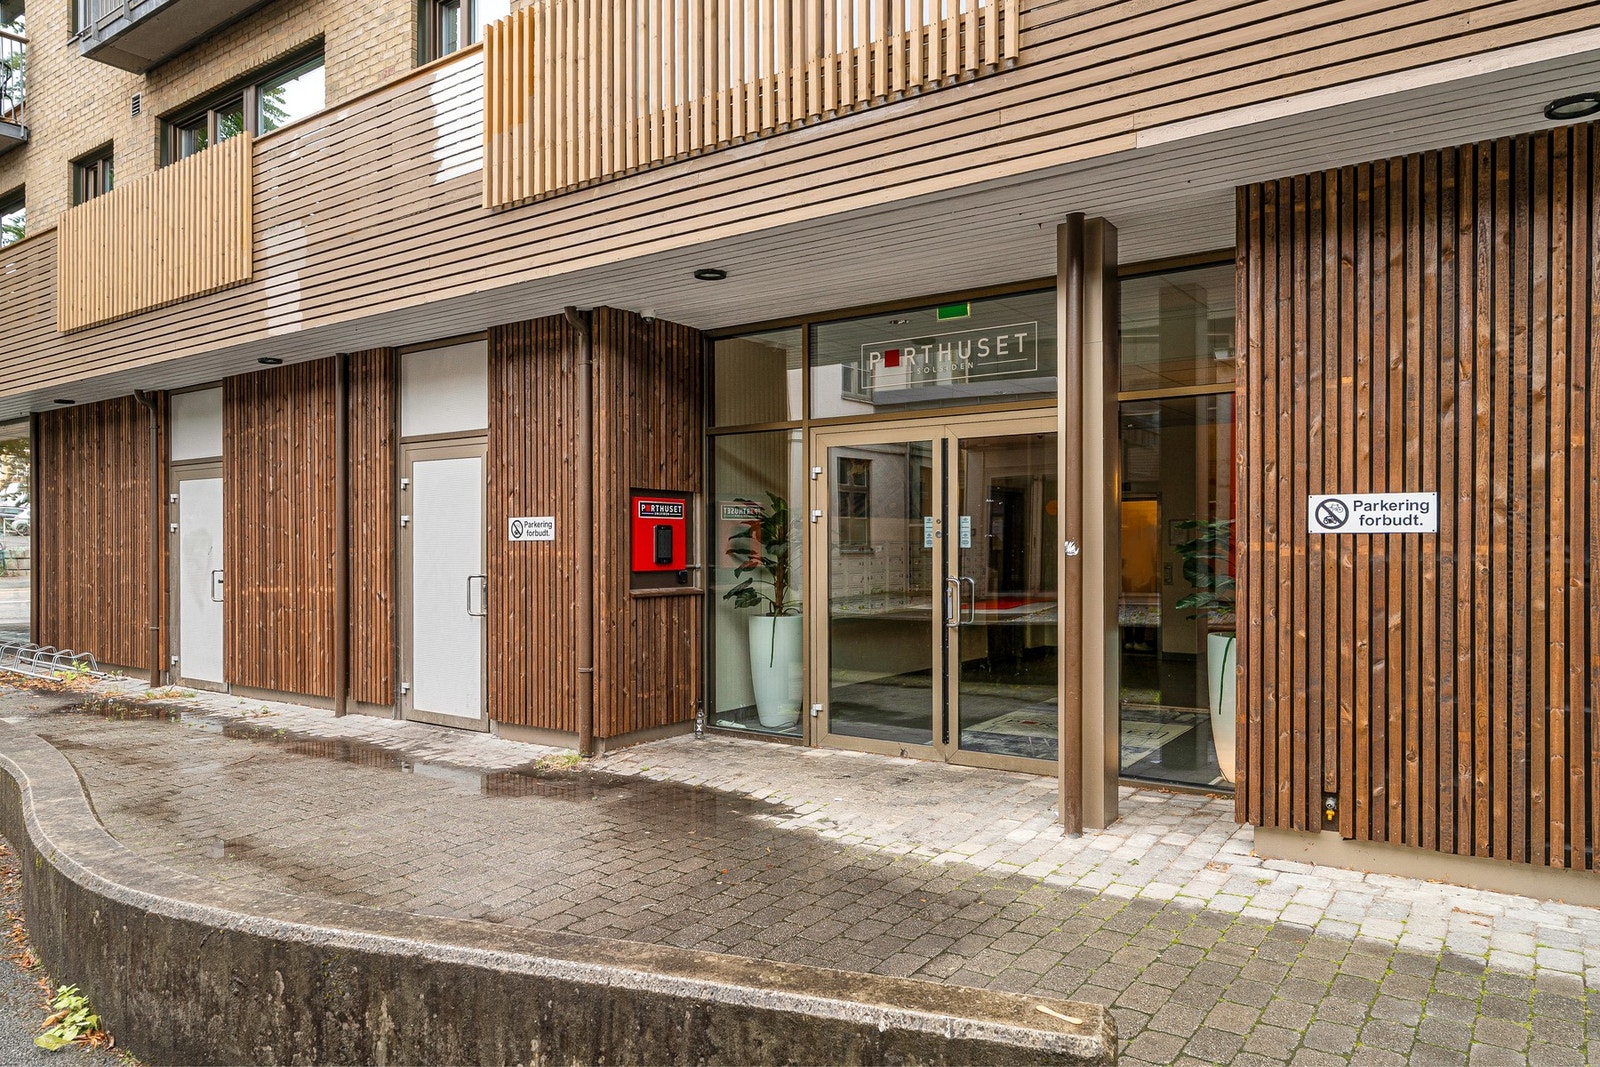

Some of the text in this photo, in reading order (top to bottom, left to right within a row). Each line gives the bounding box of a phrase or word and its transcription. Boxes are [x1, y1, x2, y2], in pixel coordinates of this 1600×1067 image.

[1353, 499, 1430, 514] Parkering
[524, 520, 553, 529] Parkering
[1359, 514, 1423, 526] forbudt.
